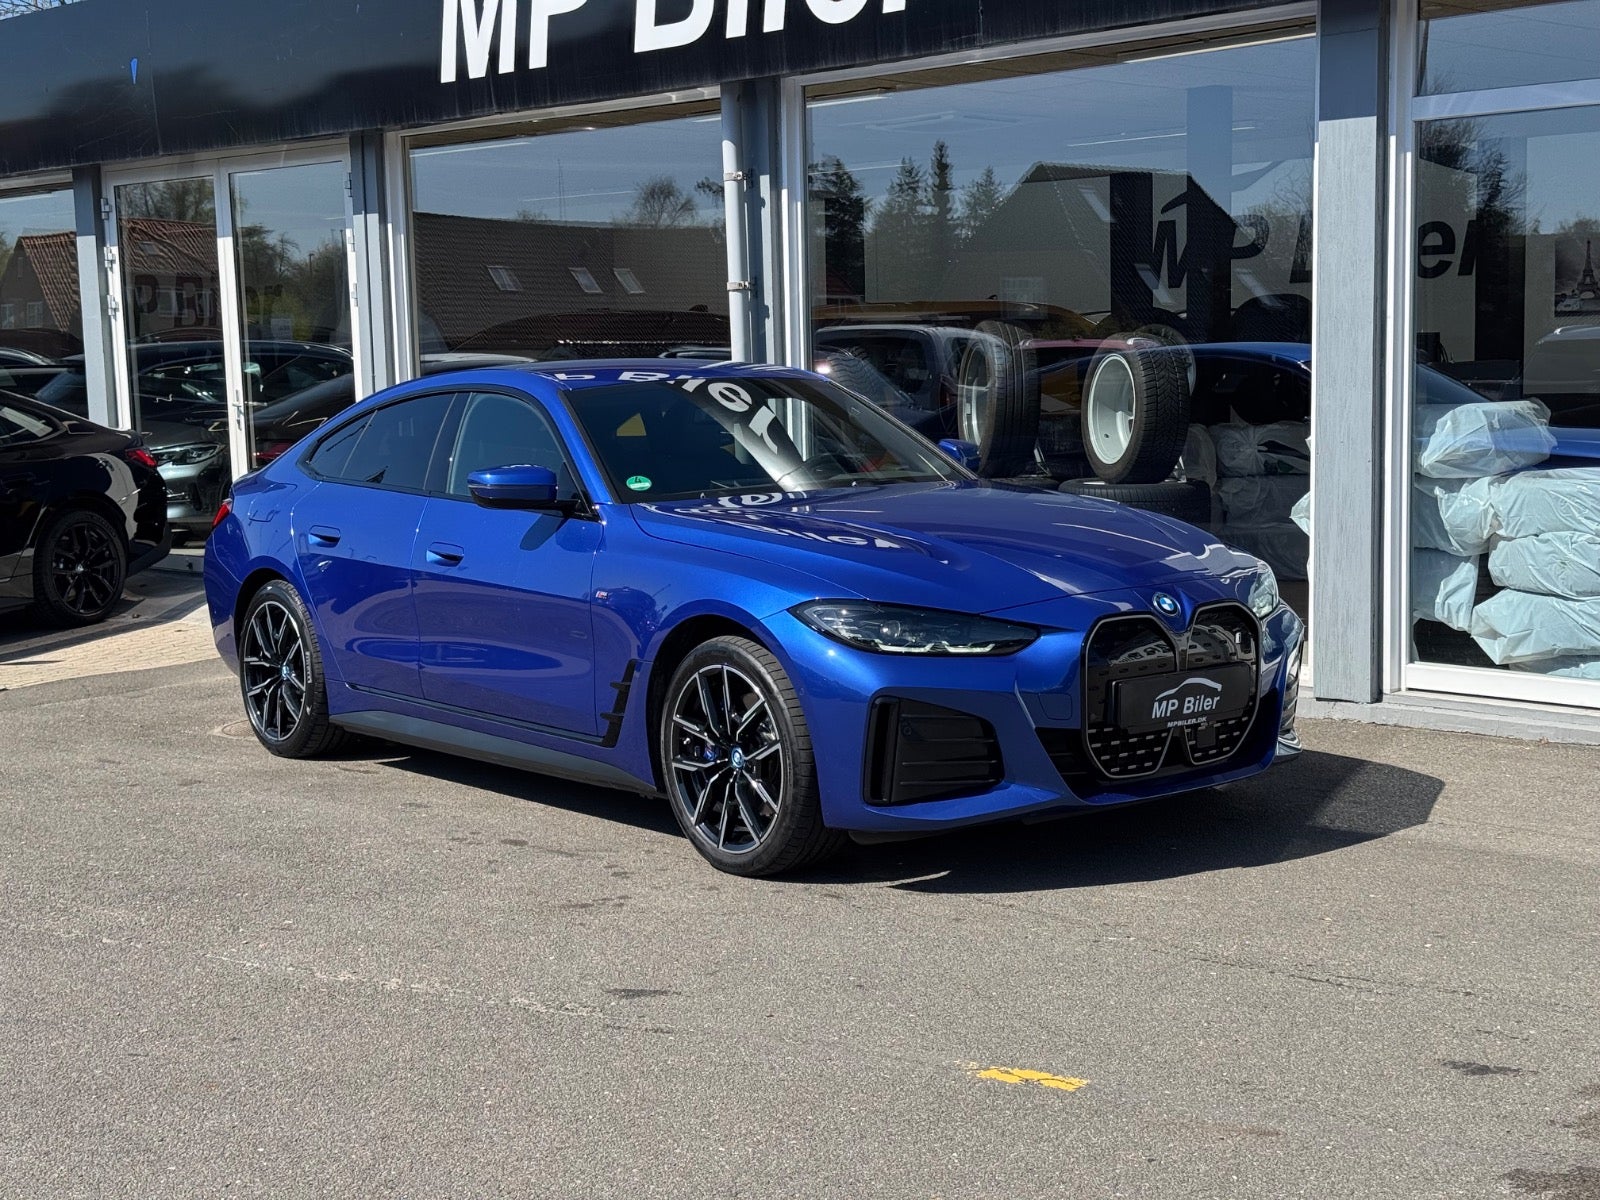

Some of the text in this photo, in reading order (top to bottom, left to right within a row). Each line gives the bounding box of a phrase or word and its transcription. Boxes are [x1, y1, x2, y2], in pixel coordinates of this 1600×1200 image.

[1152, 694, 1221, 718] MP Biler
[1167, 717, 1207, 727] MPBILER.DK
